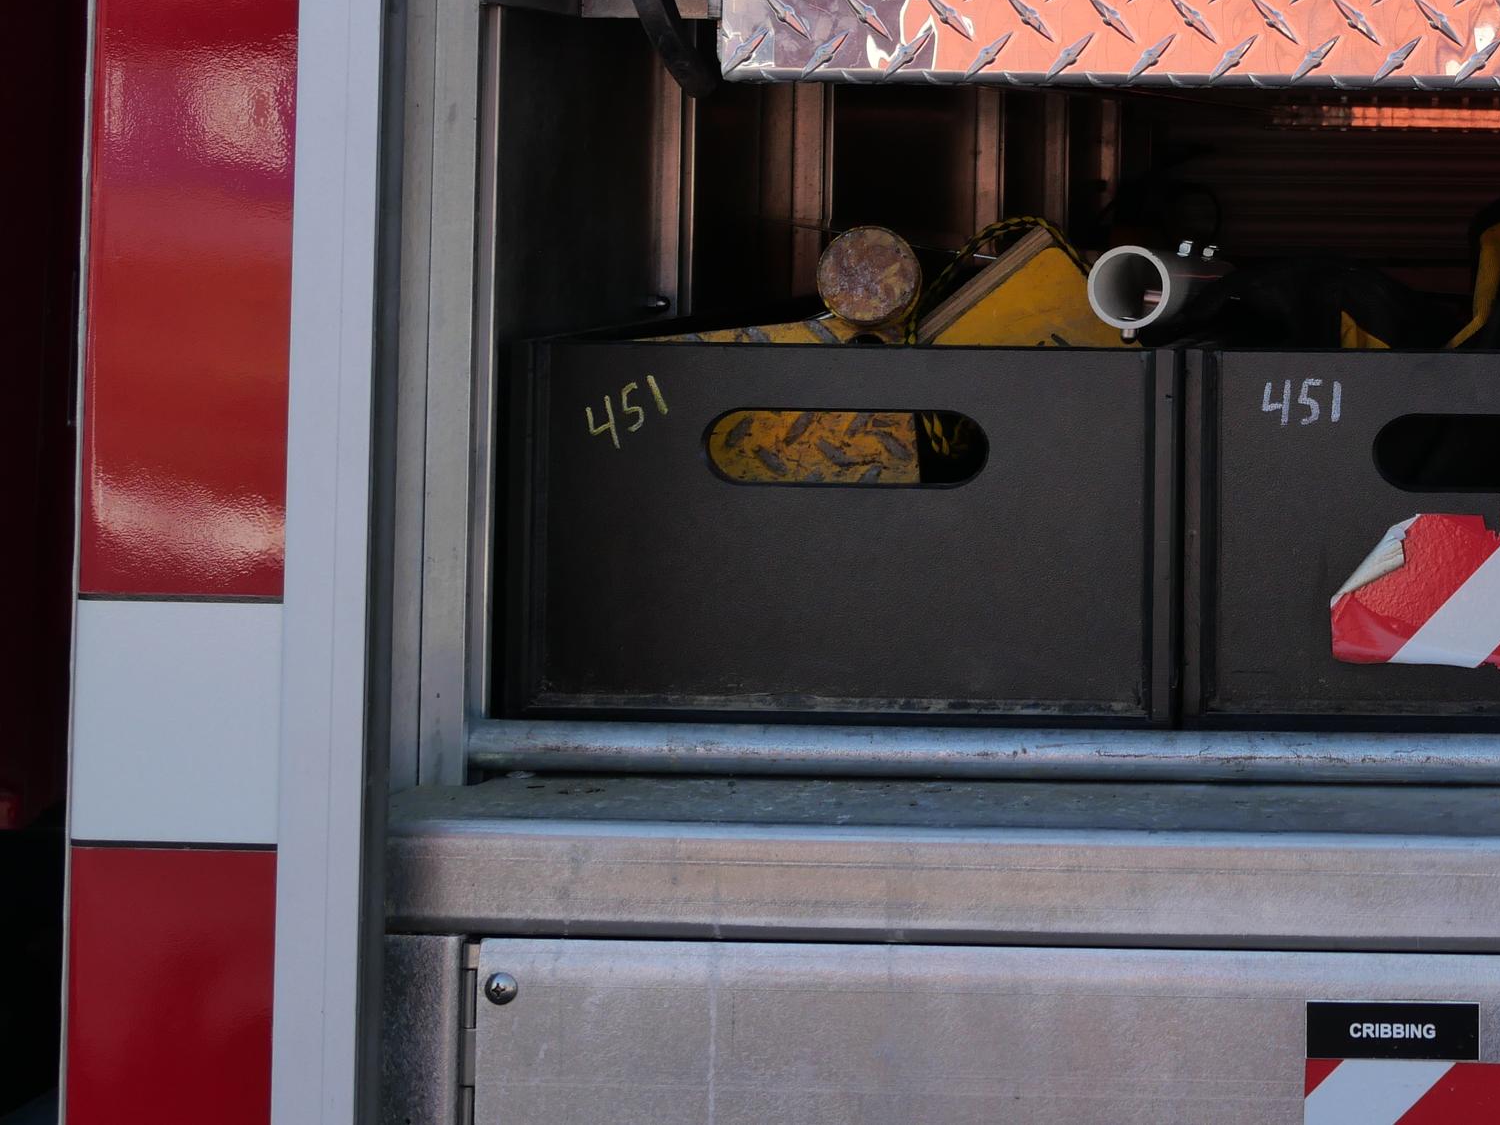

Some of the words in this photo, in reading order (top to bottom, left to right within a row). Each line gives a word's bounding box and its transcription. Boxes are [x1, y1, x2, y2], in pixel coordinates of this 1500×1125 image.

[585, 374, 669, 449] 451
[1261, 378, 1342, 426] 451
[1349, 1022, 1437, 1039] CRIBBING
